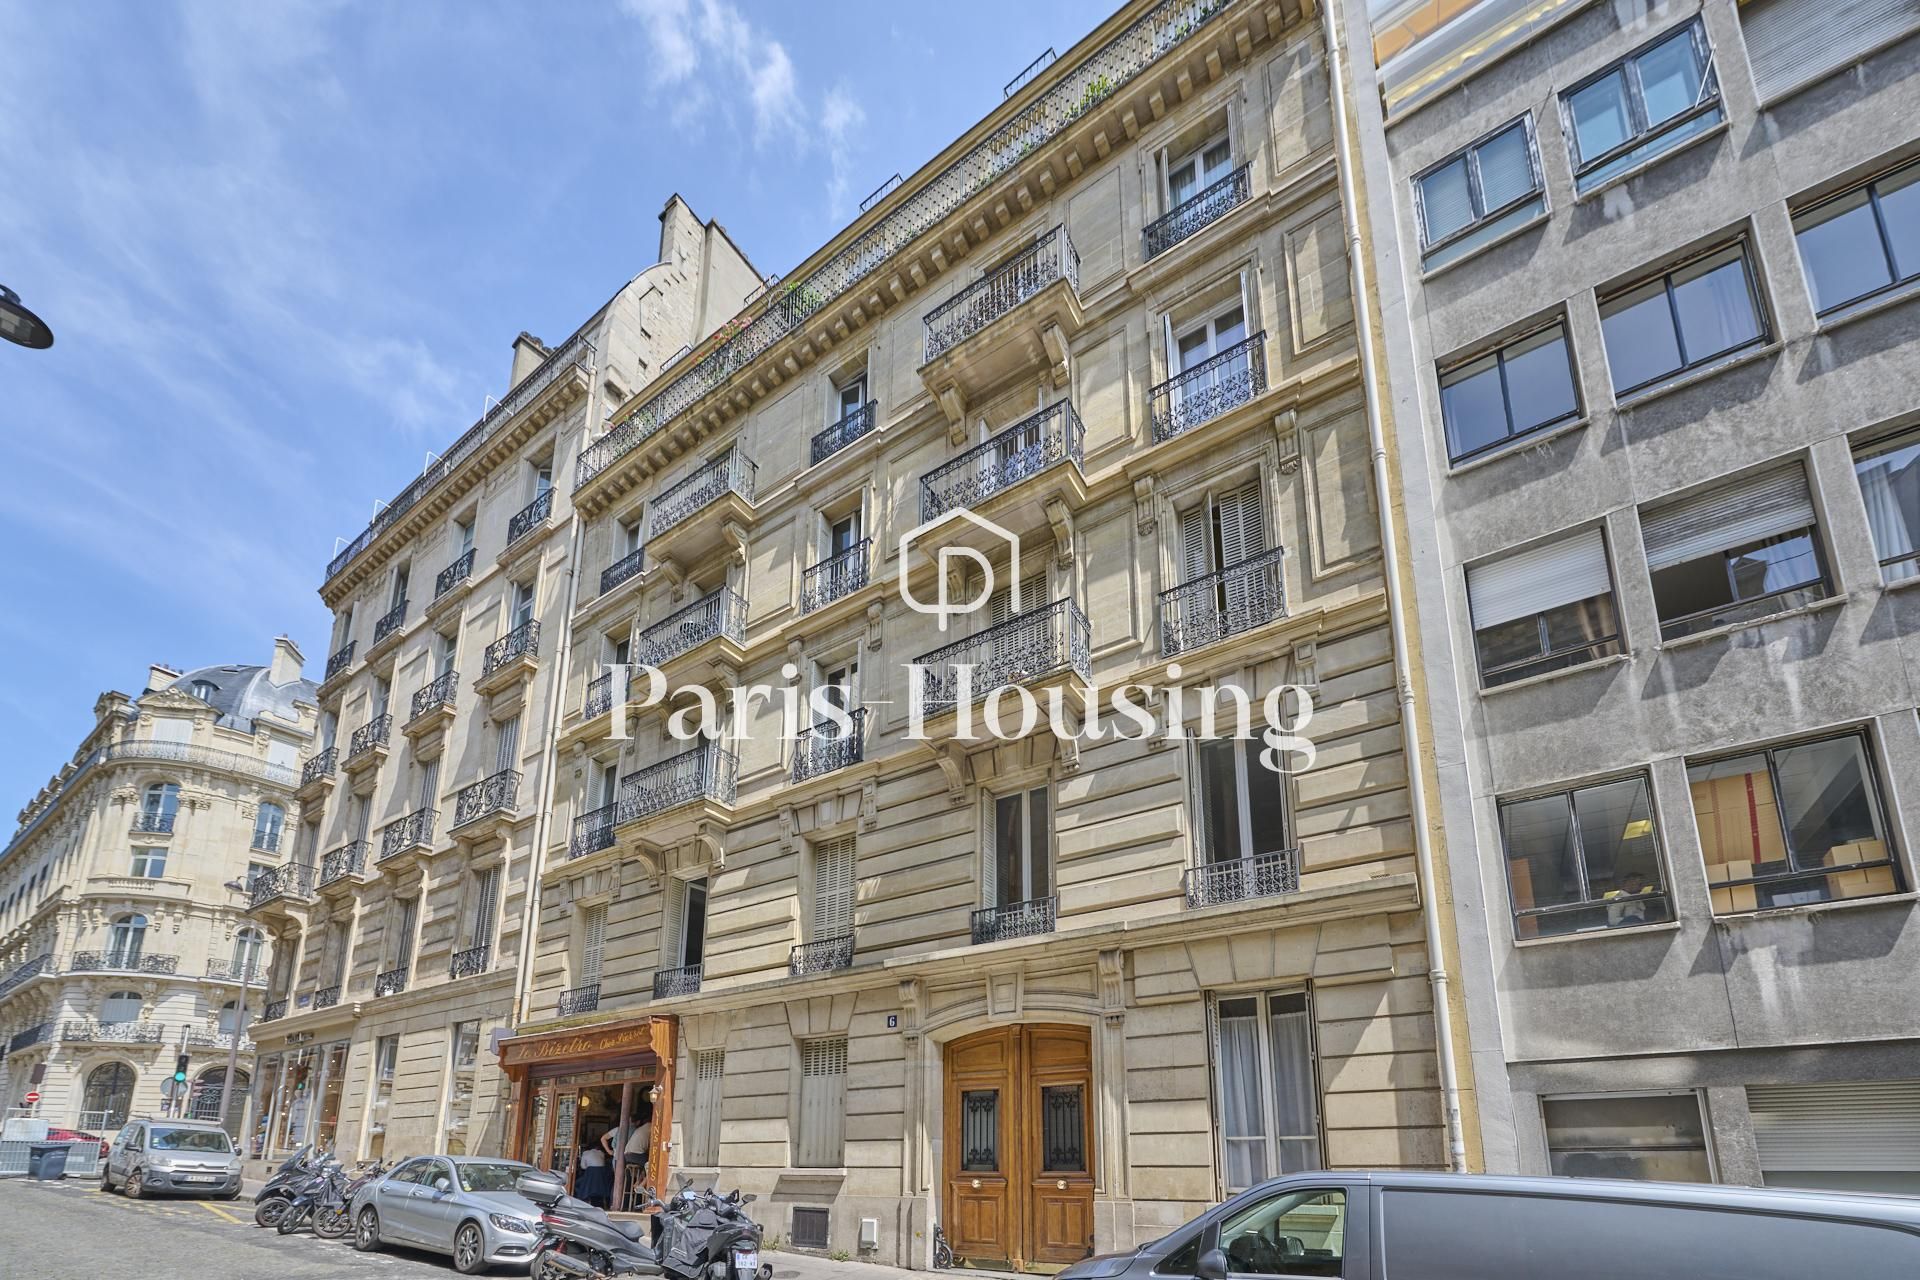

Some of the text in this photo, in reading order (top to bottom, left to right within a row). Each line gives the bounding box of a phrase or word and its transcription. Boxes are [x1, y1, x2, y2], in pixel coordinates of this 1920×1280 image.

[889, 1016, 896, 1027] 6
[650, 1110, 661, 1181] VINS FINS
